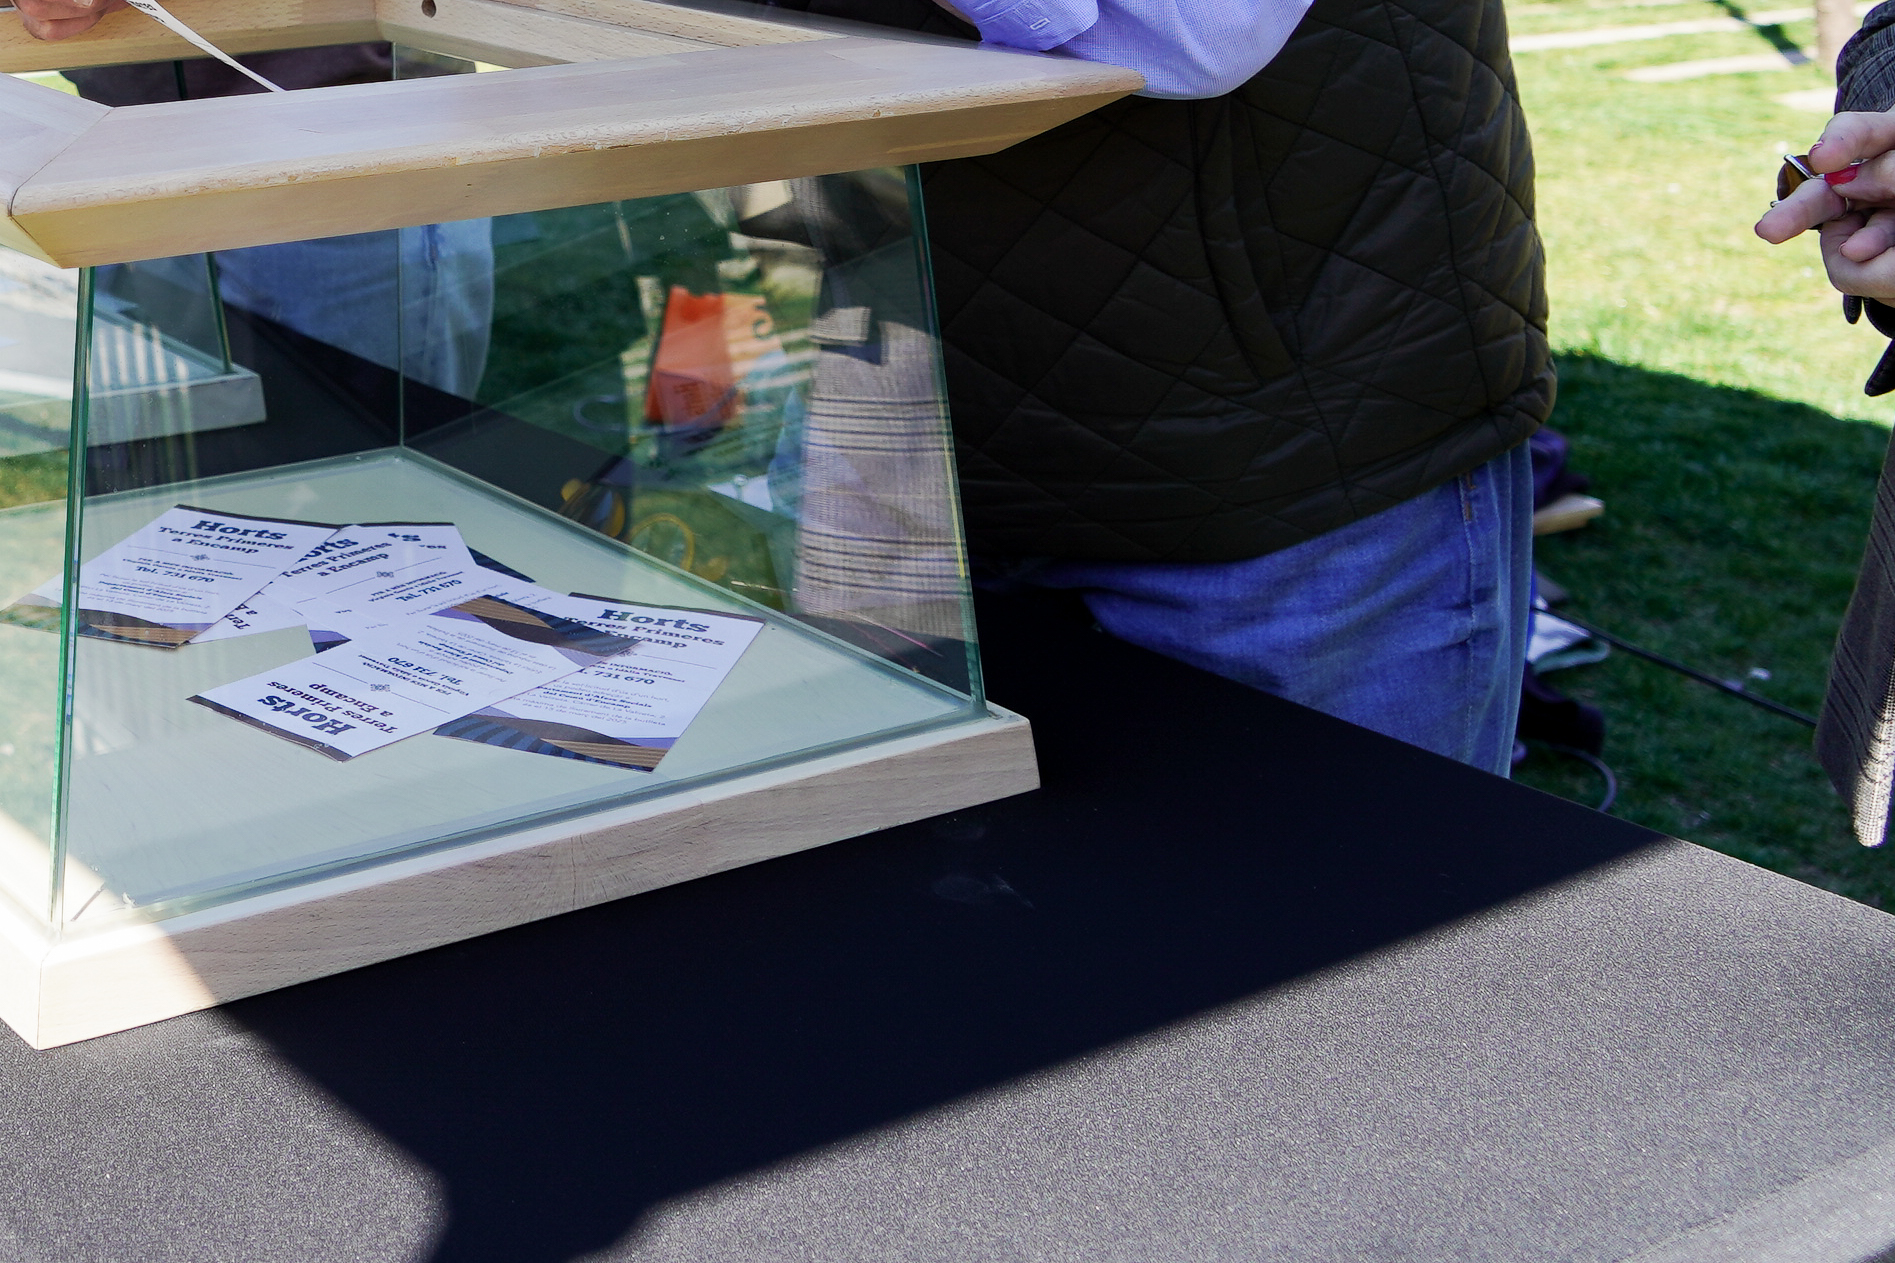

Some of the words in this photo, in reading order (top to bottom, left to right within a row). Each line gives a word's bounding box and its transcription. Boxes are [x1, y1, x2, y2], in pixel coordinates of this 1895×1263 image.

[158, 526, 214, 540] Terres
[215, 535, 294, 551] Primeres
[190, 519, 288, 541] Horts
[187, 538, 259, 554] Encamp
[297, 538, 359, 563] orts
[329, 542, 392, 563] Primeres
[330, 552, 390, 573] Encamp
[162, 570, 185, 579] 731
[188, 575, 215, 583] 670
[597, 608, 710, 633] Horts
[632, 625, 726, 646] Primeres
[387, 656, 415, 671] 670
[413, 664, 438, 678] 731
[441, 673, 464, 686] Tel.
[594, 670, 620, 680] 731
[624, 675, 655, 685] 670
[266, 681, 342, 713] Primeres
[308, 682, 380, 713] Encamp
[256, 694, 357, 736] Horts
[341, 710, 399, 734] Terres
[379, 710, 394, 718] a
